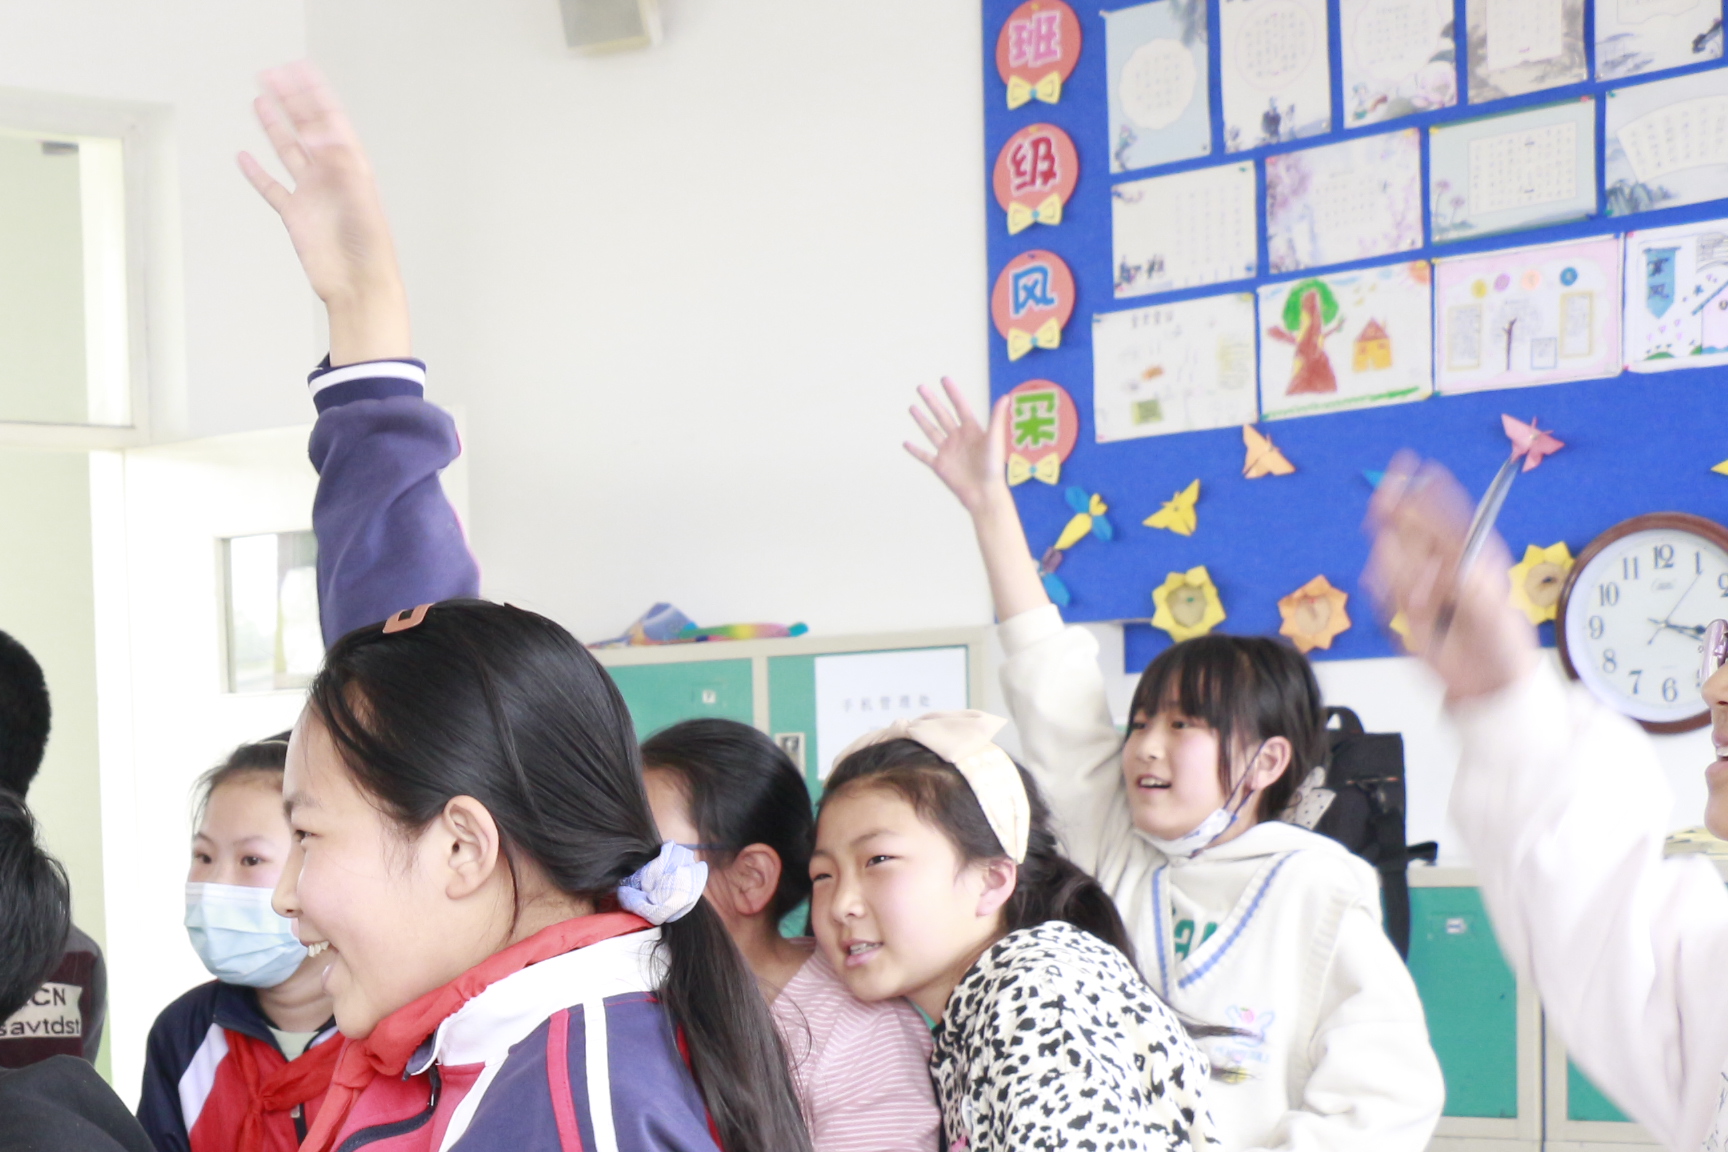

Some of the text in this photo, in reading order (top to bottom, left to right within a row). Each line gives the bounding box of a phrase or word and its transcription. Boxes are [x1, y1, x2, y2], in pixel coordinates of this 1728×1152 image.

[1623, 557, 1639, 580] 11
[1653, 544, 1675, 569] 12
[1695, 552, 1703, 576] 1
[1599, 582, 1620, 607] 10
[1589, 615, 1604, 640] 9
[1603, 649, 1617, 673] 8
[1629, 670, 1643, 695] 7
[1662, 677, 1678, 702] 6
